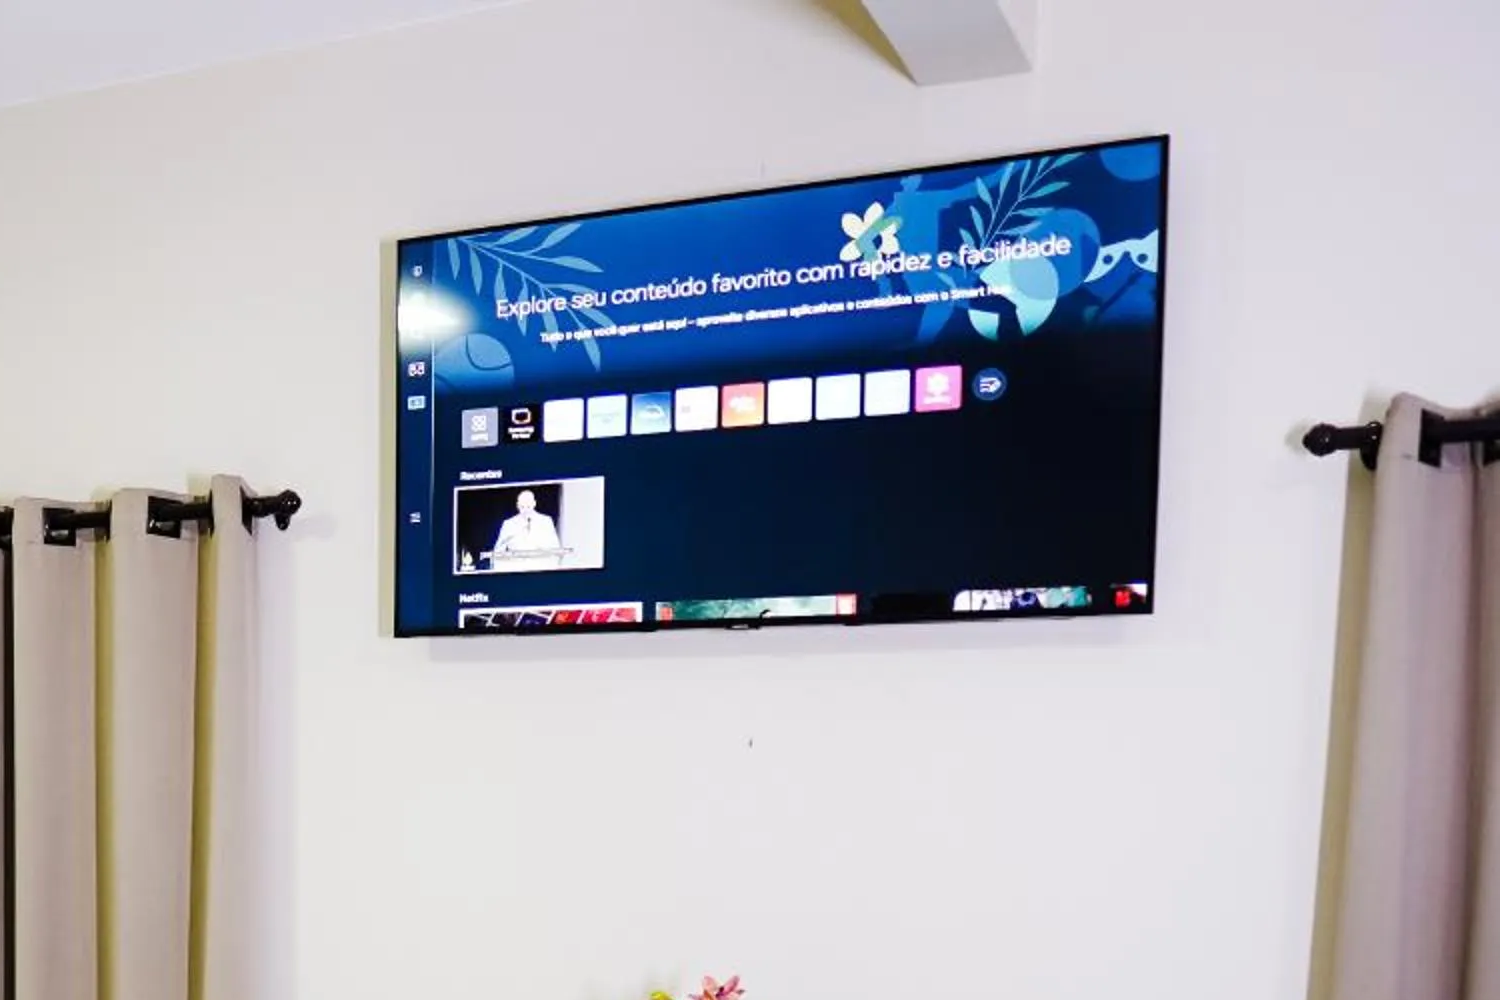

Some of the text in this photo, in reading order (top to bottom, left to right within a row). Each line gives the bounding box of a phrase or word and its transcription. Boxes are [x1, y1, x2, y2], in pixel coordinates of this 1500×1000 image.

[496, 234, 1071, 319] Explore seu conteúdo favorito com rapidez e facilidade
